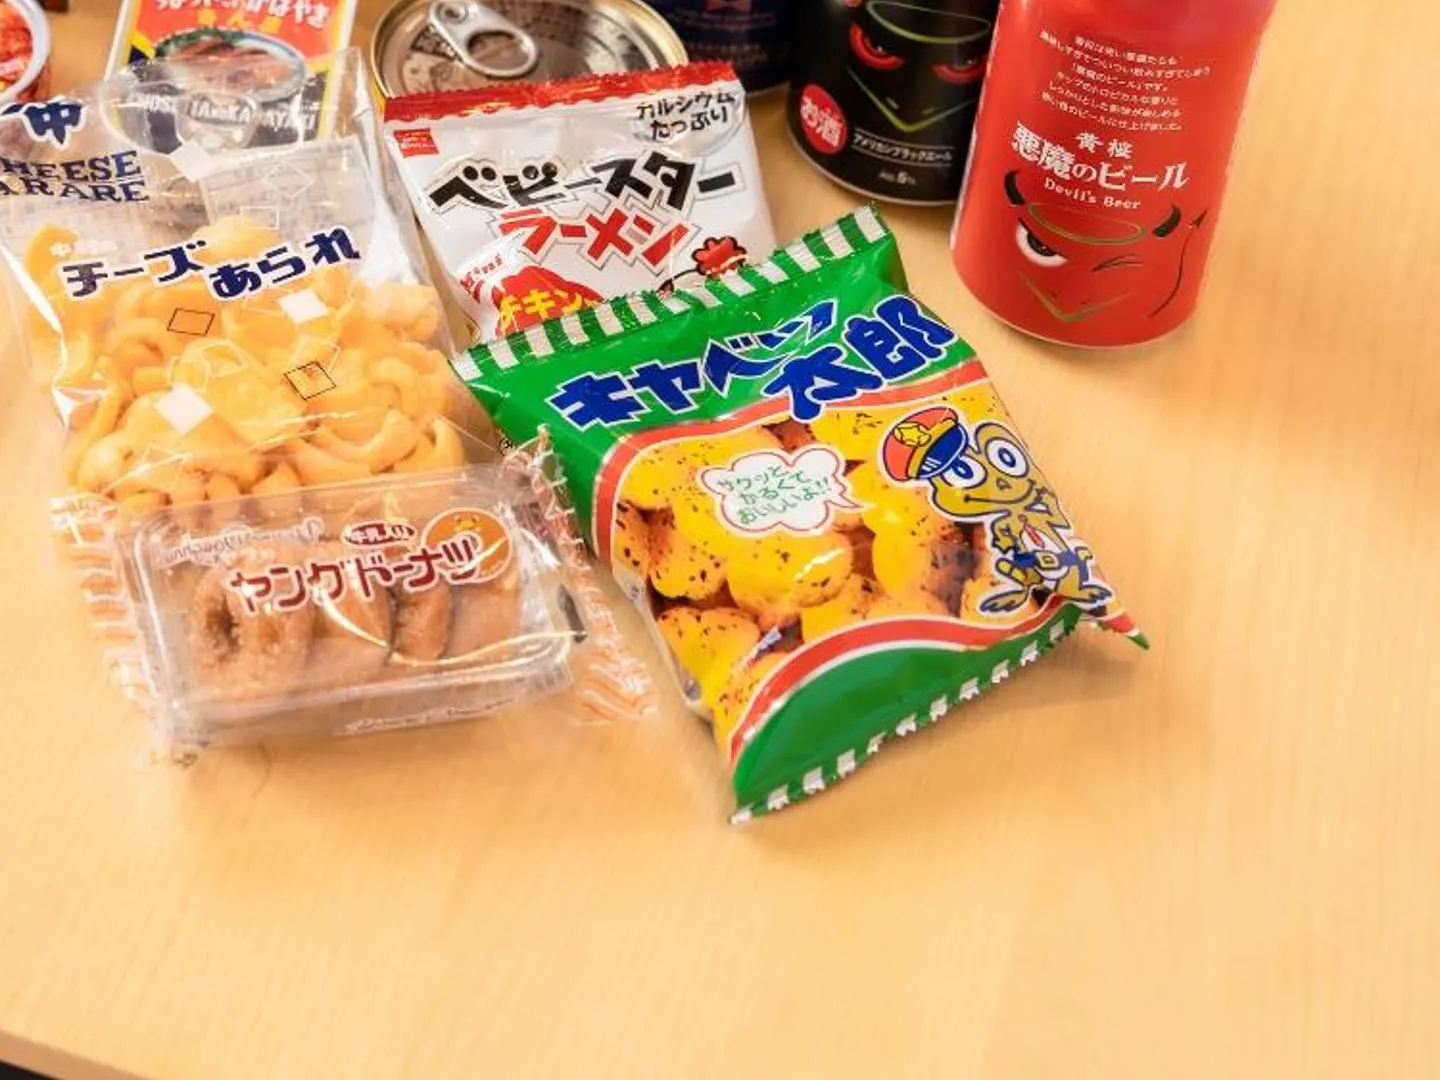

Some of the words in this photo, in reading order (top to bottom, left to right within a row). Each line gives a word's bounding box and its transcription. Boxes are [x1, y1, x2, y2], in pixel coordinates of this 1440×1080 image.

[636, 91, 736, 122] カルシウム
[427, 150, 737, 211] ベビースター
[1011, 120, 1190, 192] 悪魔のビール
[1043, 176, 1097, 204] Devil's
[1103, 195, 1142, 210] Beer
[498, 208, 690, 269] ラーメン
[547, 300, 838, 429] キャベツ
[763, 296, 959, 421] 太郎
[229, 545, 478, 613] ヤングドーナツ
